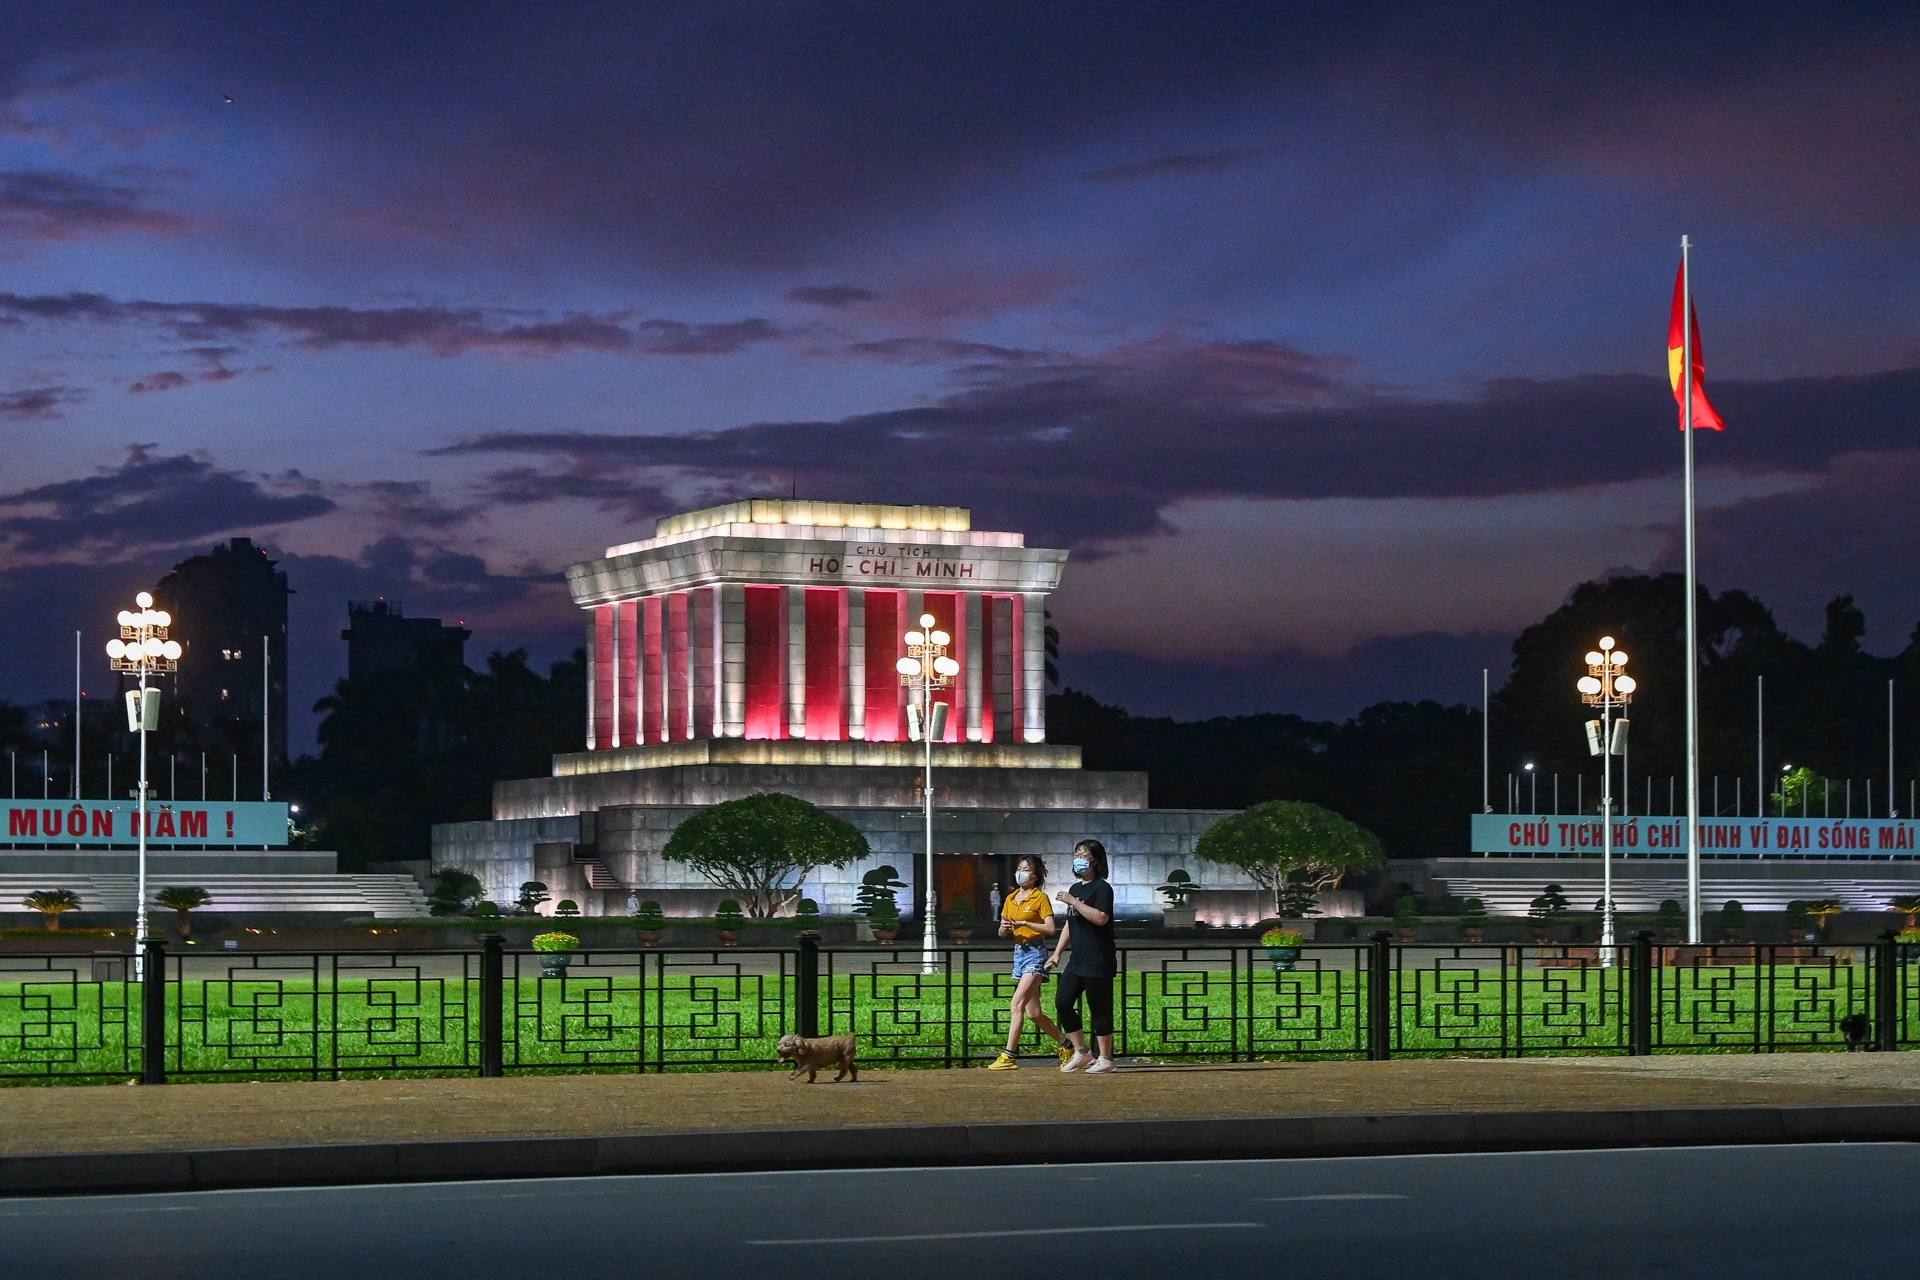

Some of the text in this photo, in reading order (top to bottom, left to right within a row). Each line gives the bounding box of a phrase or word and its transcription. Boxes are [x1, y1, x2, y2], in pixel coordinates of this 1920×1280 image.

[9, 803, 113, 837] MUÔN
[131, 804, 208, 838] NĂM
[1509, 816, 1549, 847] CHỦ
[1558, 822, 1604, 851] TỊCH
[1648, 820, 1680, 848] CHÍ
[1750, 821, 1768, 848] VĨ
[1777, 825, 1810, 853] ĐẠI
[1818, 819, 1870, 848] SỐNG
[1879, 822, 1914, 849] MÃI
